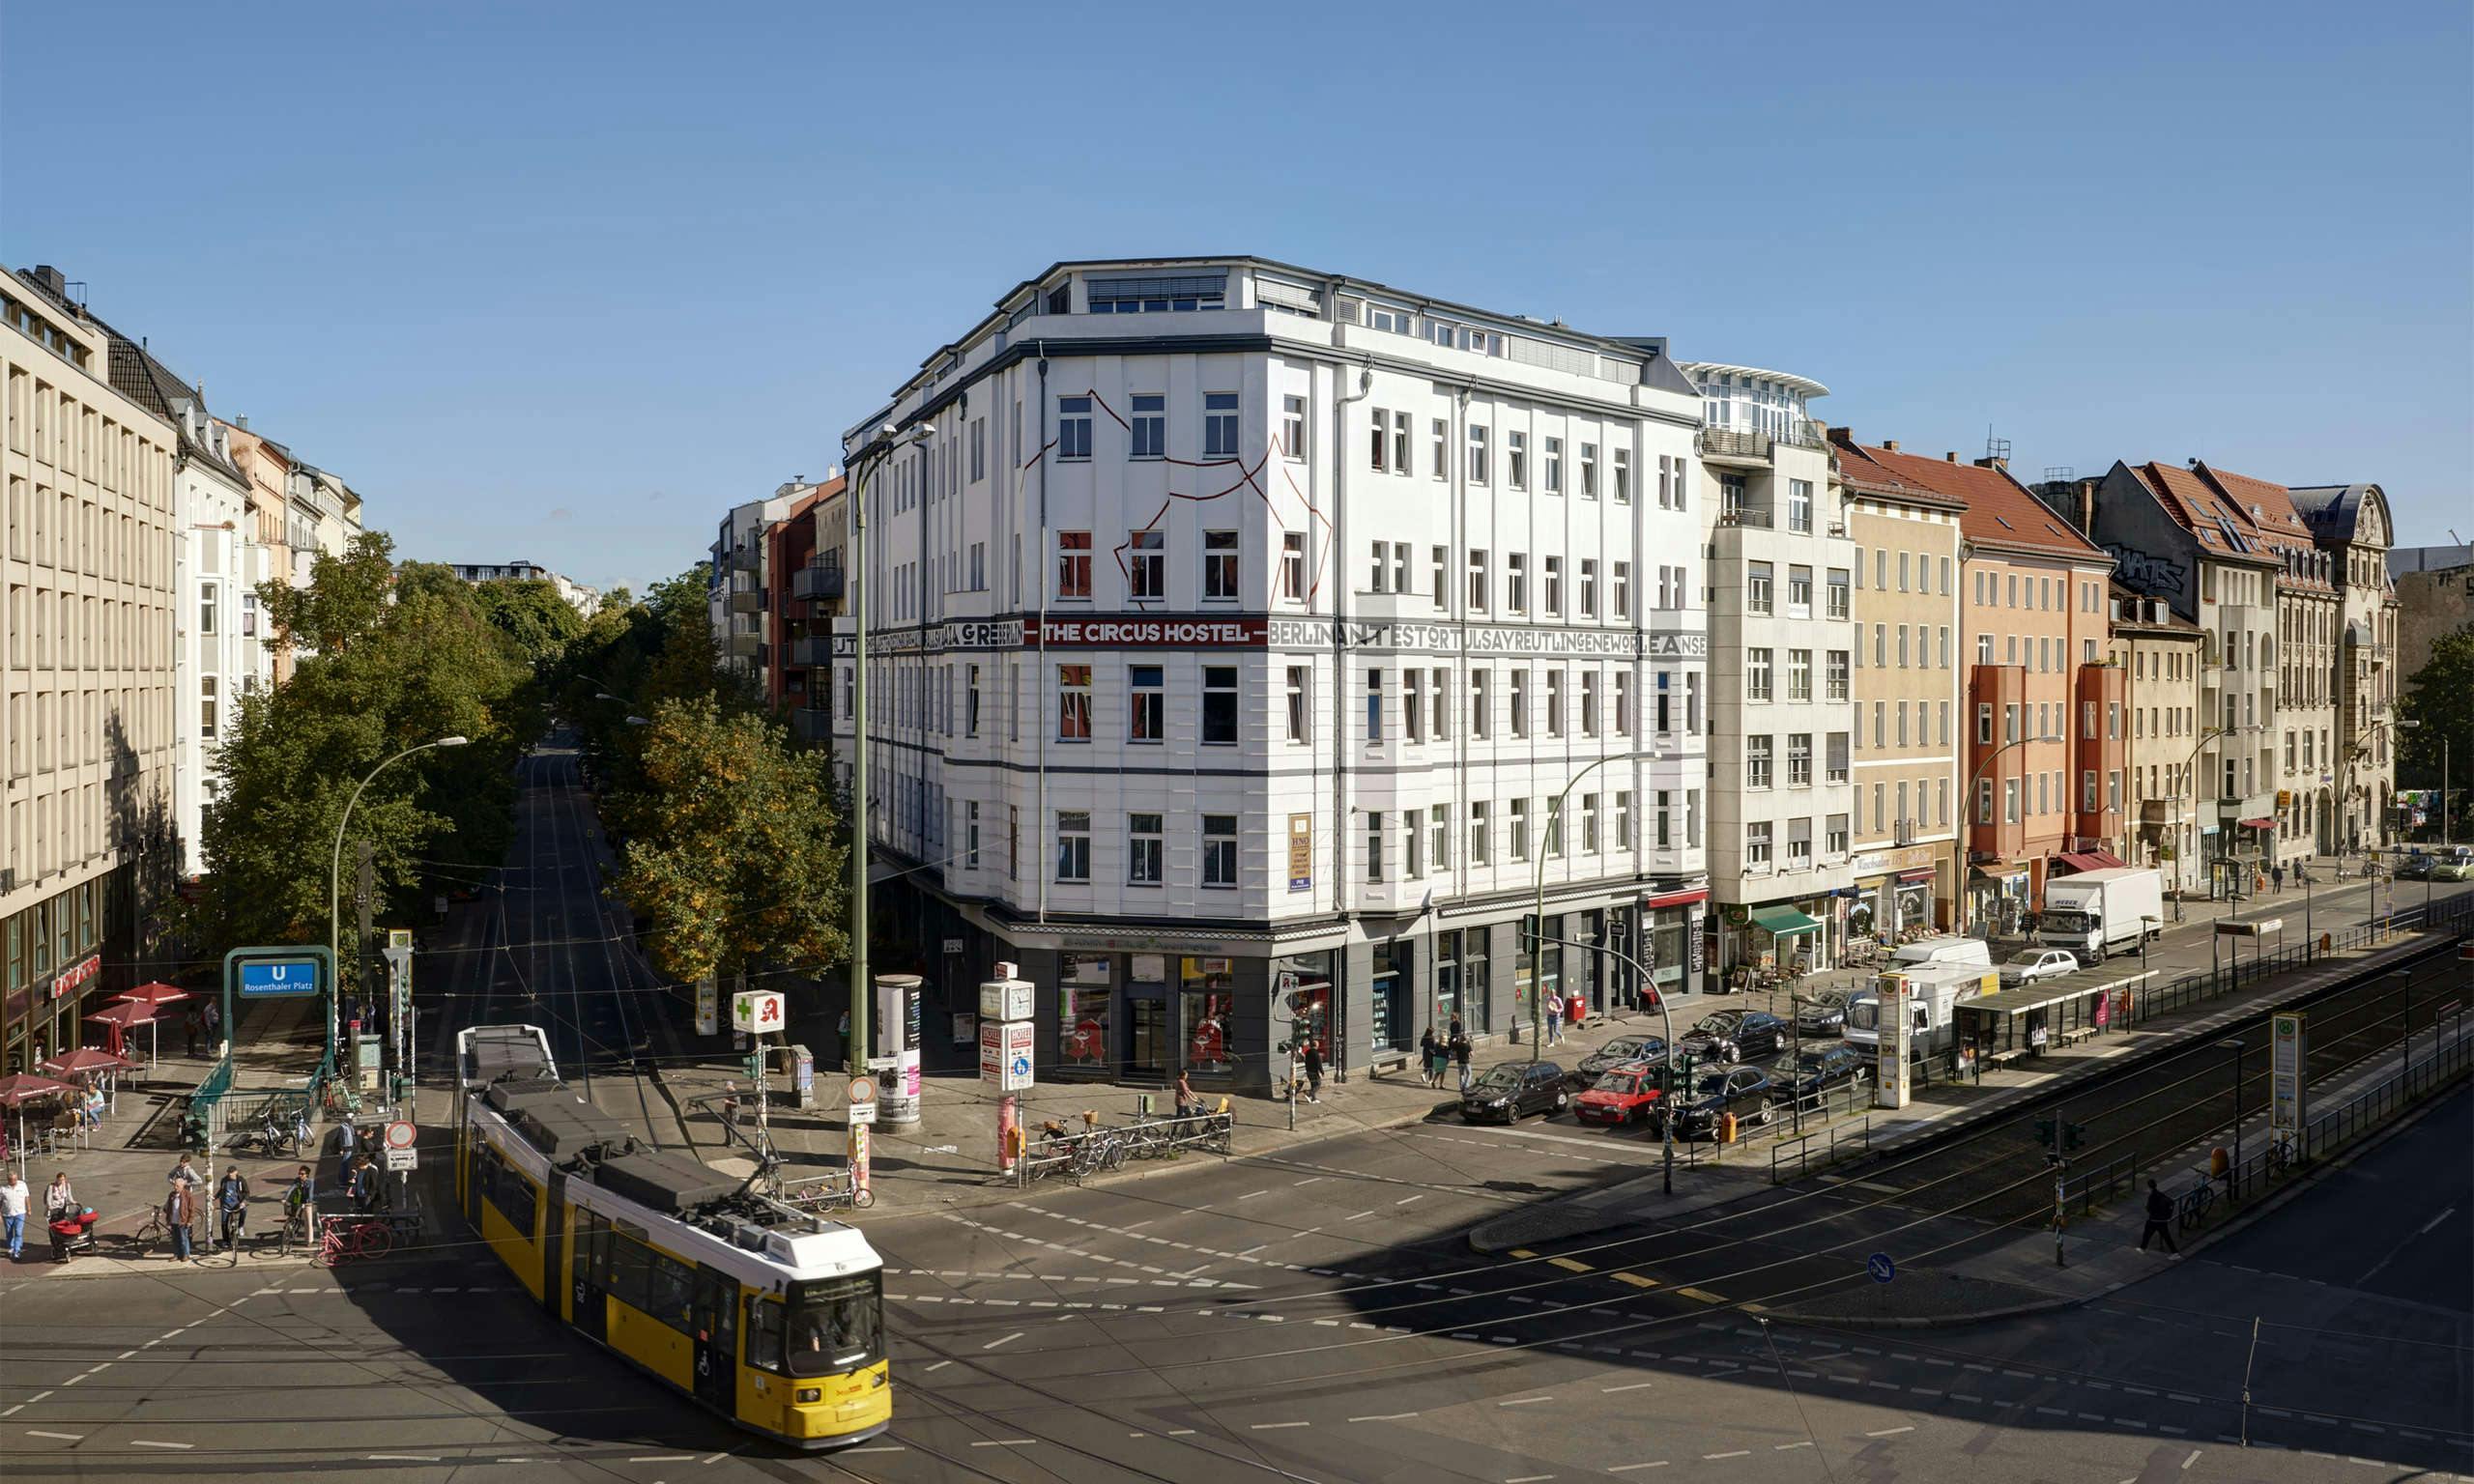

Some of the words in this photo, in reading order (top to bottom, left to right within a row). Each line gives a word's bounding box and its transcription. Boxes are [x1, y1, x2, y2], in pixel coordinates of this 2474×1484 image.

[1043, 623, 1081, 642] THE
[1084, 622, 1161, 642] CIRCUS
[1164, 623, 1250, 642] HOSTEL
[1291, 837, 1309, 846] HNO
[272, 965, 286, 981] U
[244, 982, 292, 992] Rosenthaler
[293, 981, 313, 990] Platz
[982, 1028, 1001, 1040] HOTEL
[1012, 1028, 1031, 1041] HOTEL
